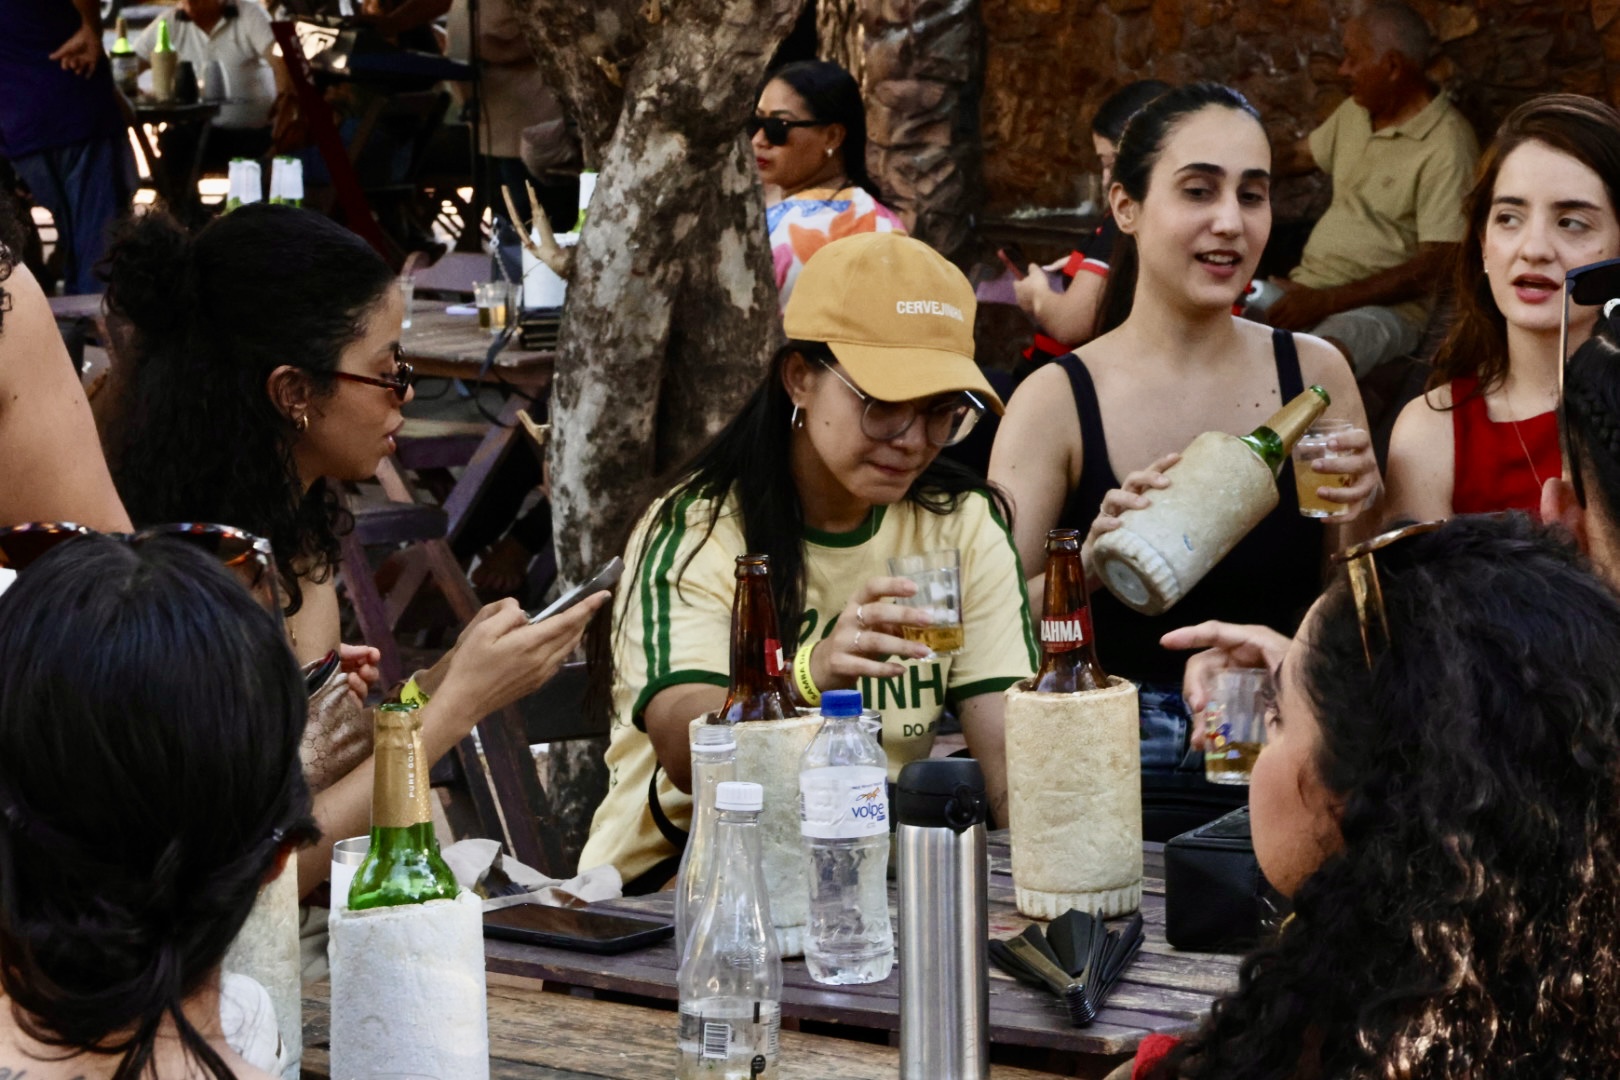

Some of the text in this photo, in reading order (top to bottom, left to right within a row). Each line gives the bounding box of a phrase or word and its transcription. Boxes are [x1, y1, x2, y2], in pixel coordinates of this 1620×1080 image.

[1040, 619, 1083, 642] RAHMA
[903, 723, 925, 738] DO
[406, 743, 416, 799] PURE GOLD
[851, 802, 885, 820] volpe
